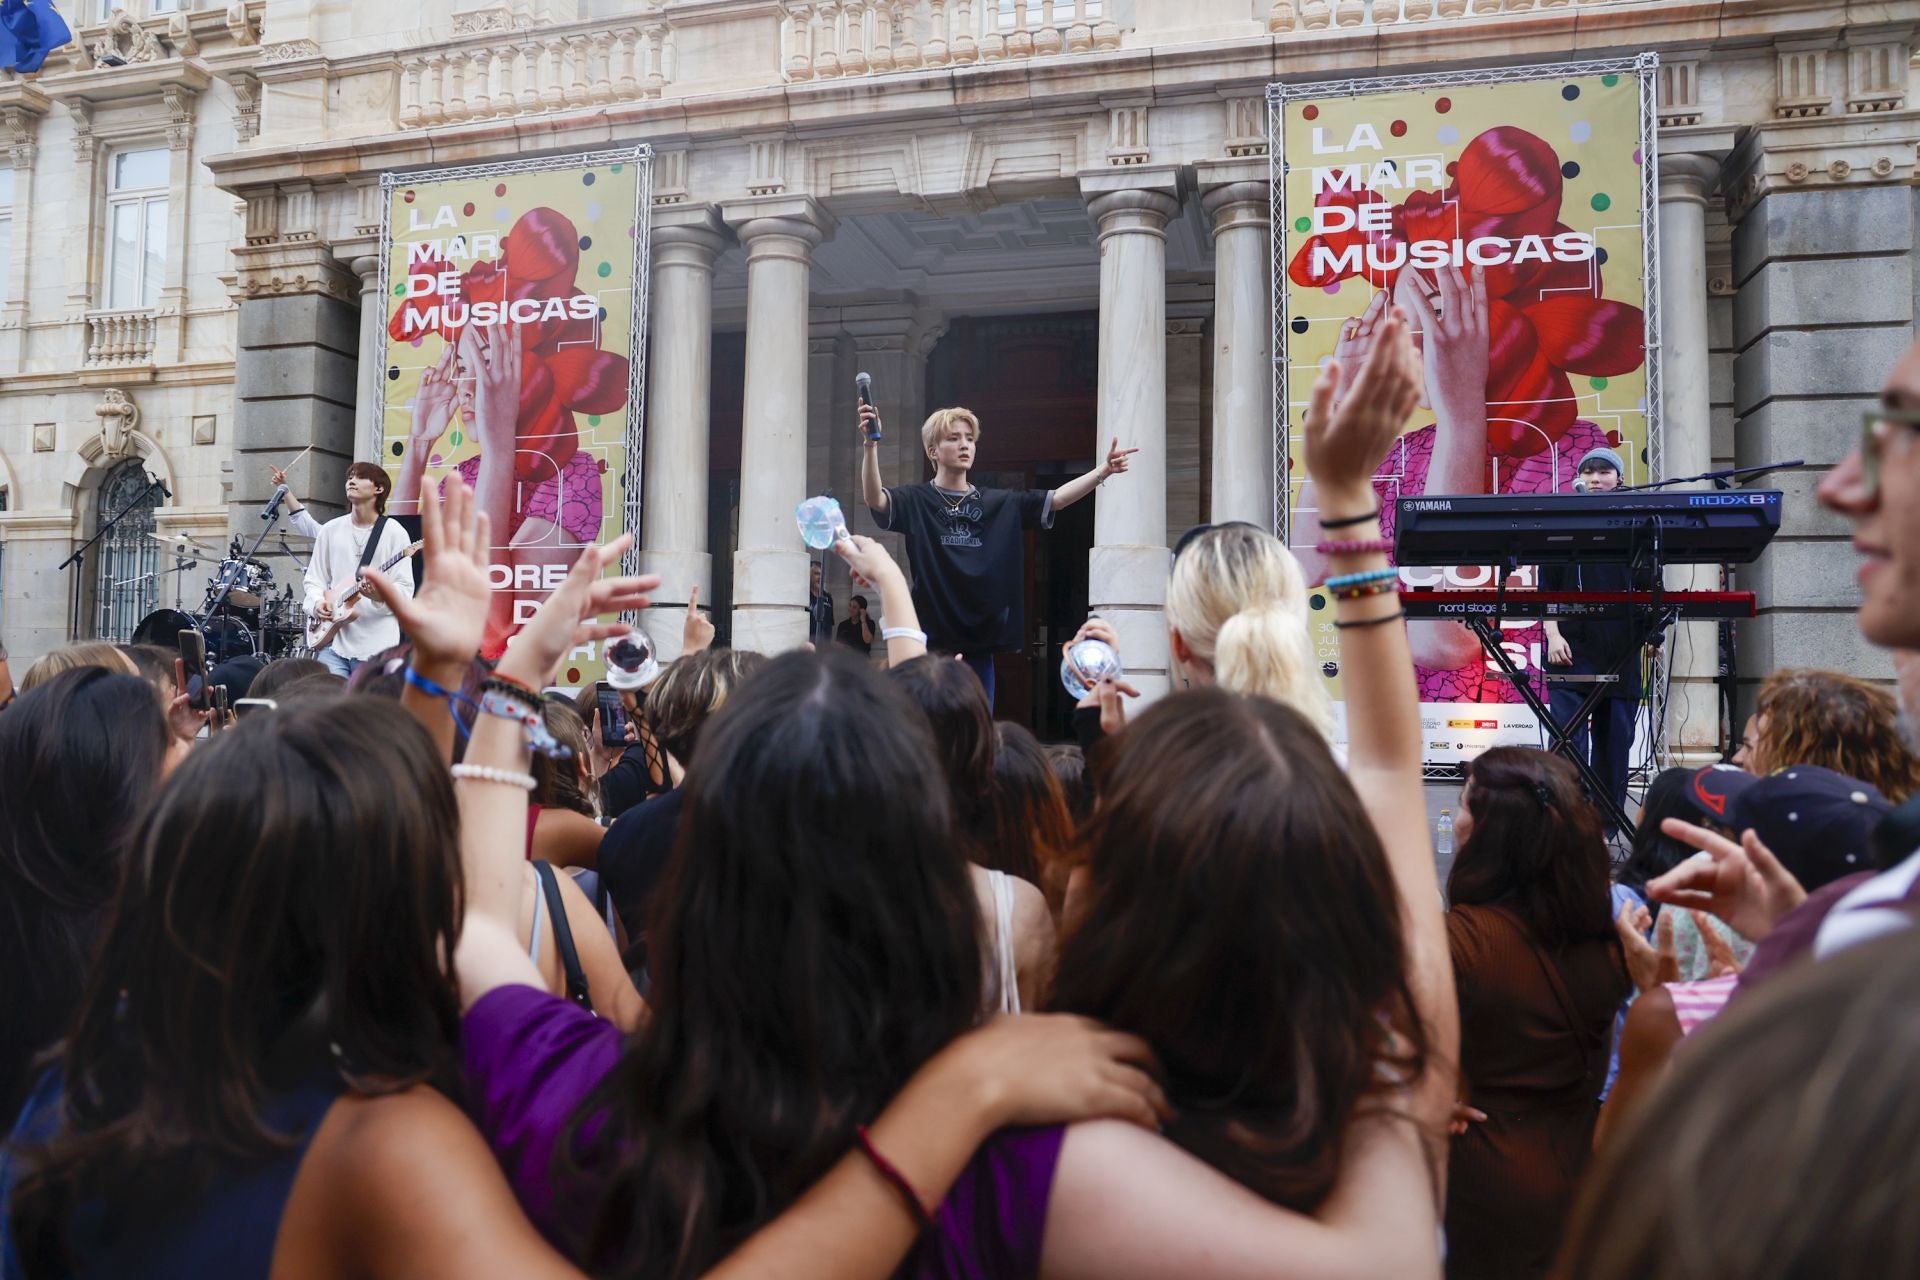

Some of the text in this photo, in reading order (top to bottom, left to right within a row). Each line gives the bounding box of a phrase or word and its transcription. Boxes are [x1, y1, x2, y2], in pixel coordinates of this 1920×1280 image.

[1312, 123, 1384, 155] LA
[1311, 159, 1443, 195] MAR
[409, 205, 458, 232] LA
[1312, 202, 1393, 234] DE
[407, 234, 498, 265] MAR
[1312, 231, 1595, 277] MÚSICAS
[406, 271, 461, 298] DE
[404, 294, 599, 333] MÚSICAS
[1414, 501, 1452, 511] YAMAHA
[488, 564, 569, 589] ORE
[1438, 603, 1508, 614] nord stage 4
